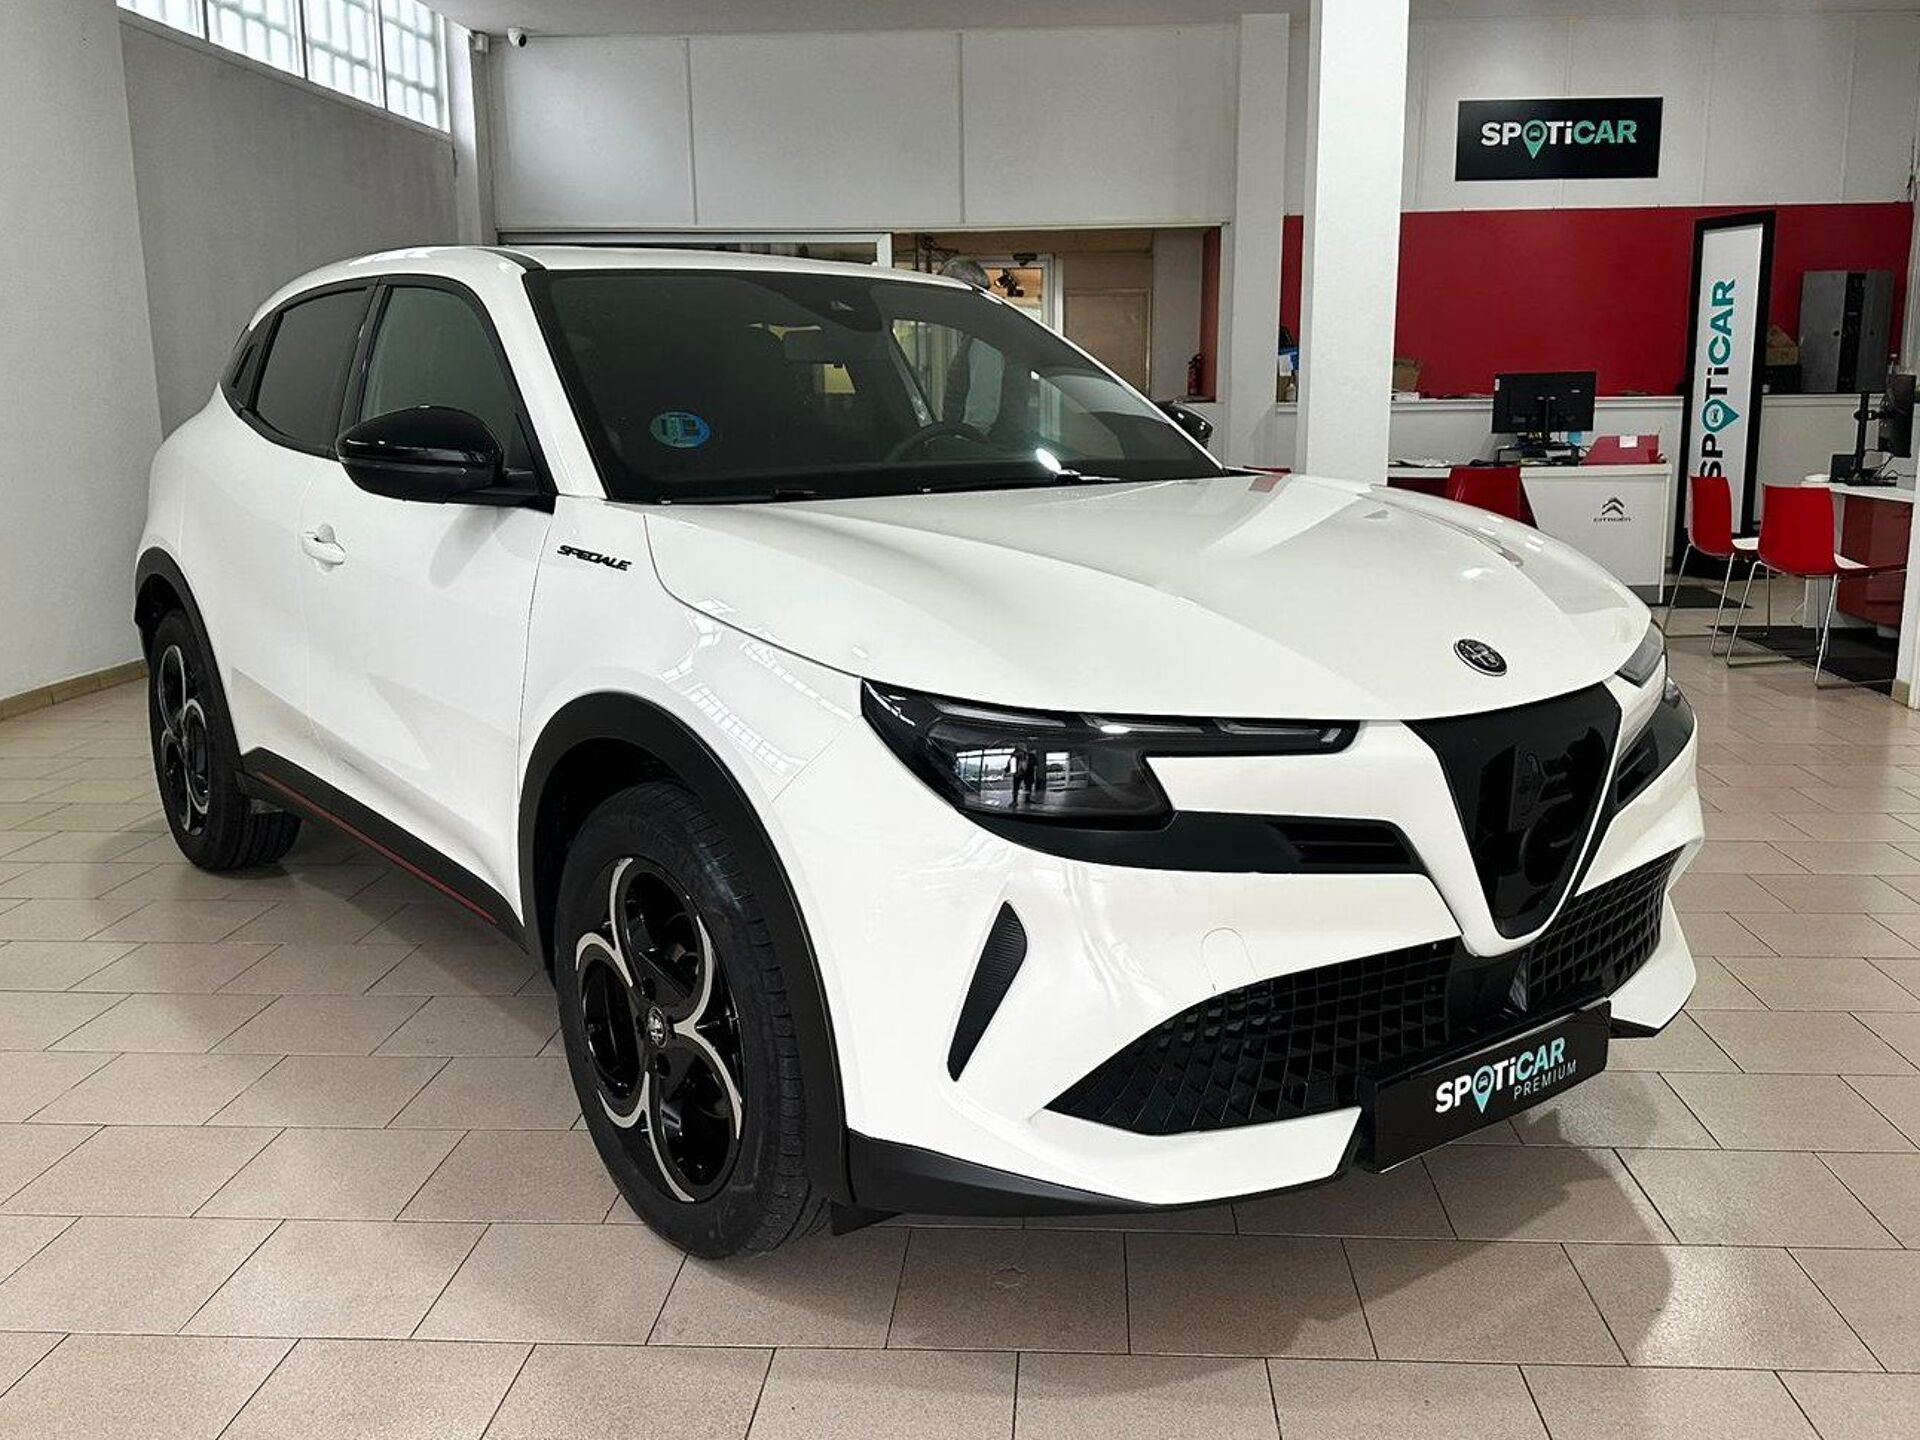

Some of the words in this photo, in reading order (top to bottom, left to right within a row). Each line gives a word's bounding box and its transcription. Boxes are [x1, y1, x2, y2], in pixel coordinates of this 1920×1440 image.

[1481, 119, 1638, 159] SPOTiCAR
[557, 544, 632, 572] SPECIALE
[1435, 1036, 1566, 1113] SPOTiCAR
[1513, 1059, 1577, 1100] PREMIUM
